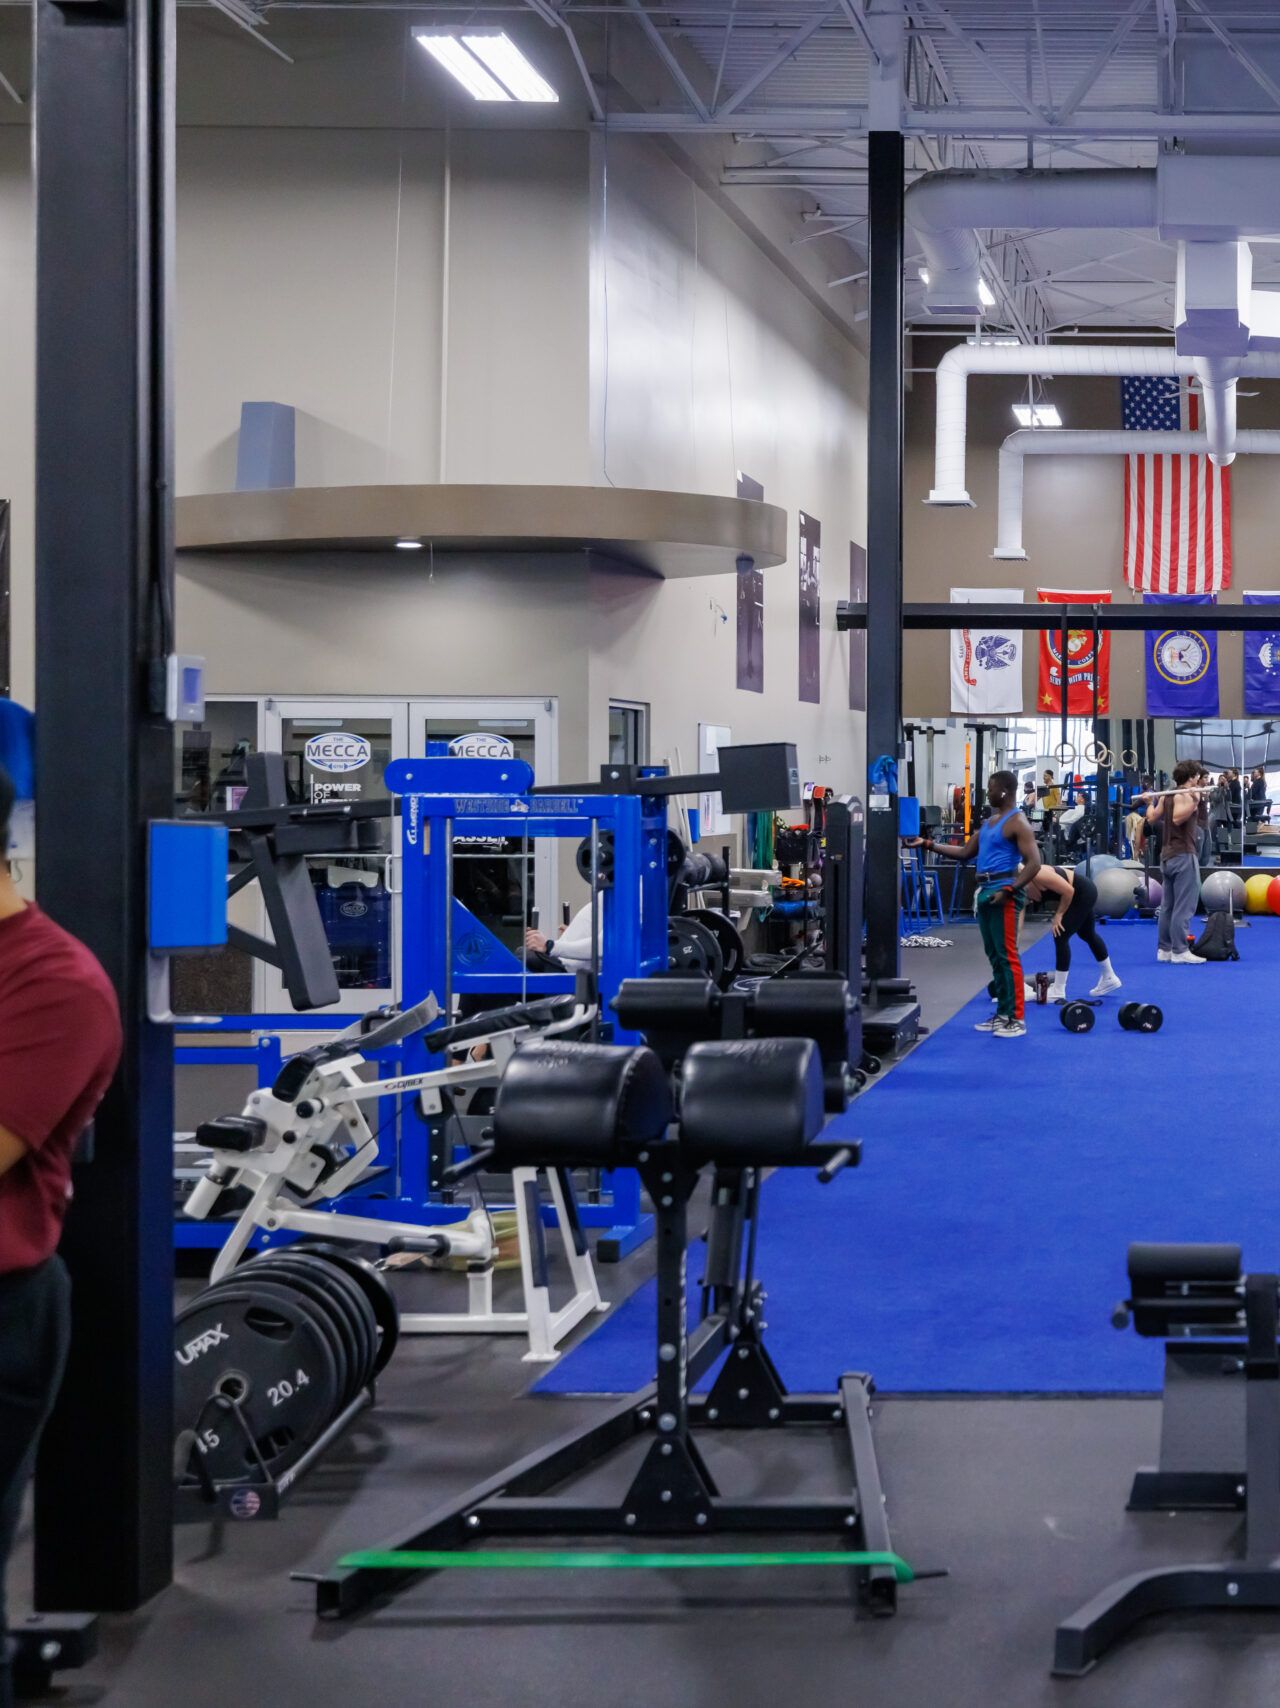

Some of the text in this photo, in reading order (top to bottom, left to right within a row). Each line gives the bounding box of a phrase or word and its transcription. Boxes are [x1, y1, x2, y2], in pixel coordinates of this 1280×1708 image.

[307, 744, 368, 757] MECCA
[451, 745, 512, 758] MECCA
[314, 783, 361, 792] POWER
[314, 791, 330, 800] OF
[174, 1323, 229, 1365] UMAX
[267, 1368, 311, 1407] 20.4
